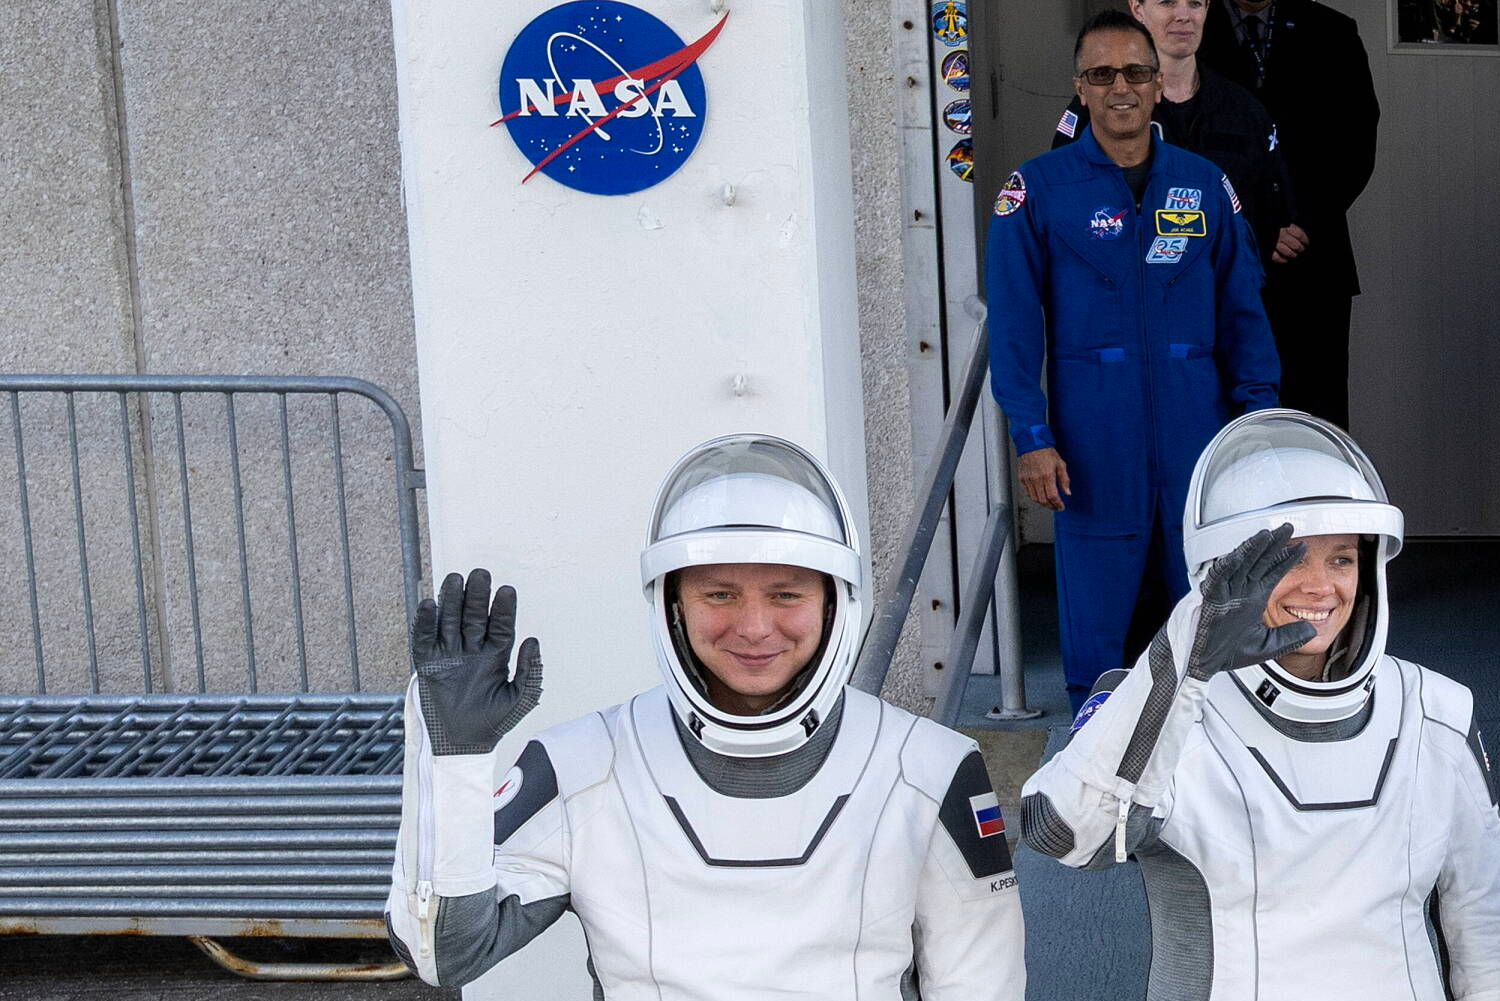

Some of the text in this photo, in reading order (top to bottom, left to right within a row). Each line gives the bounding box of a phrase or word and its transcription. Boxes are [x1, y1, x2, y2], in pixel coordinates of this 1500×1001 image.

[515, 78, 697, 118] NASA
[1091, 219, 1123, 229] NASA
[1152, 240, 1181, 259] 25
